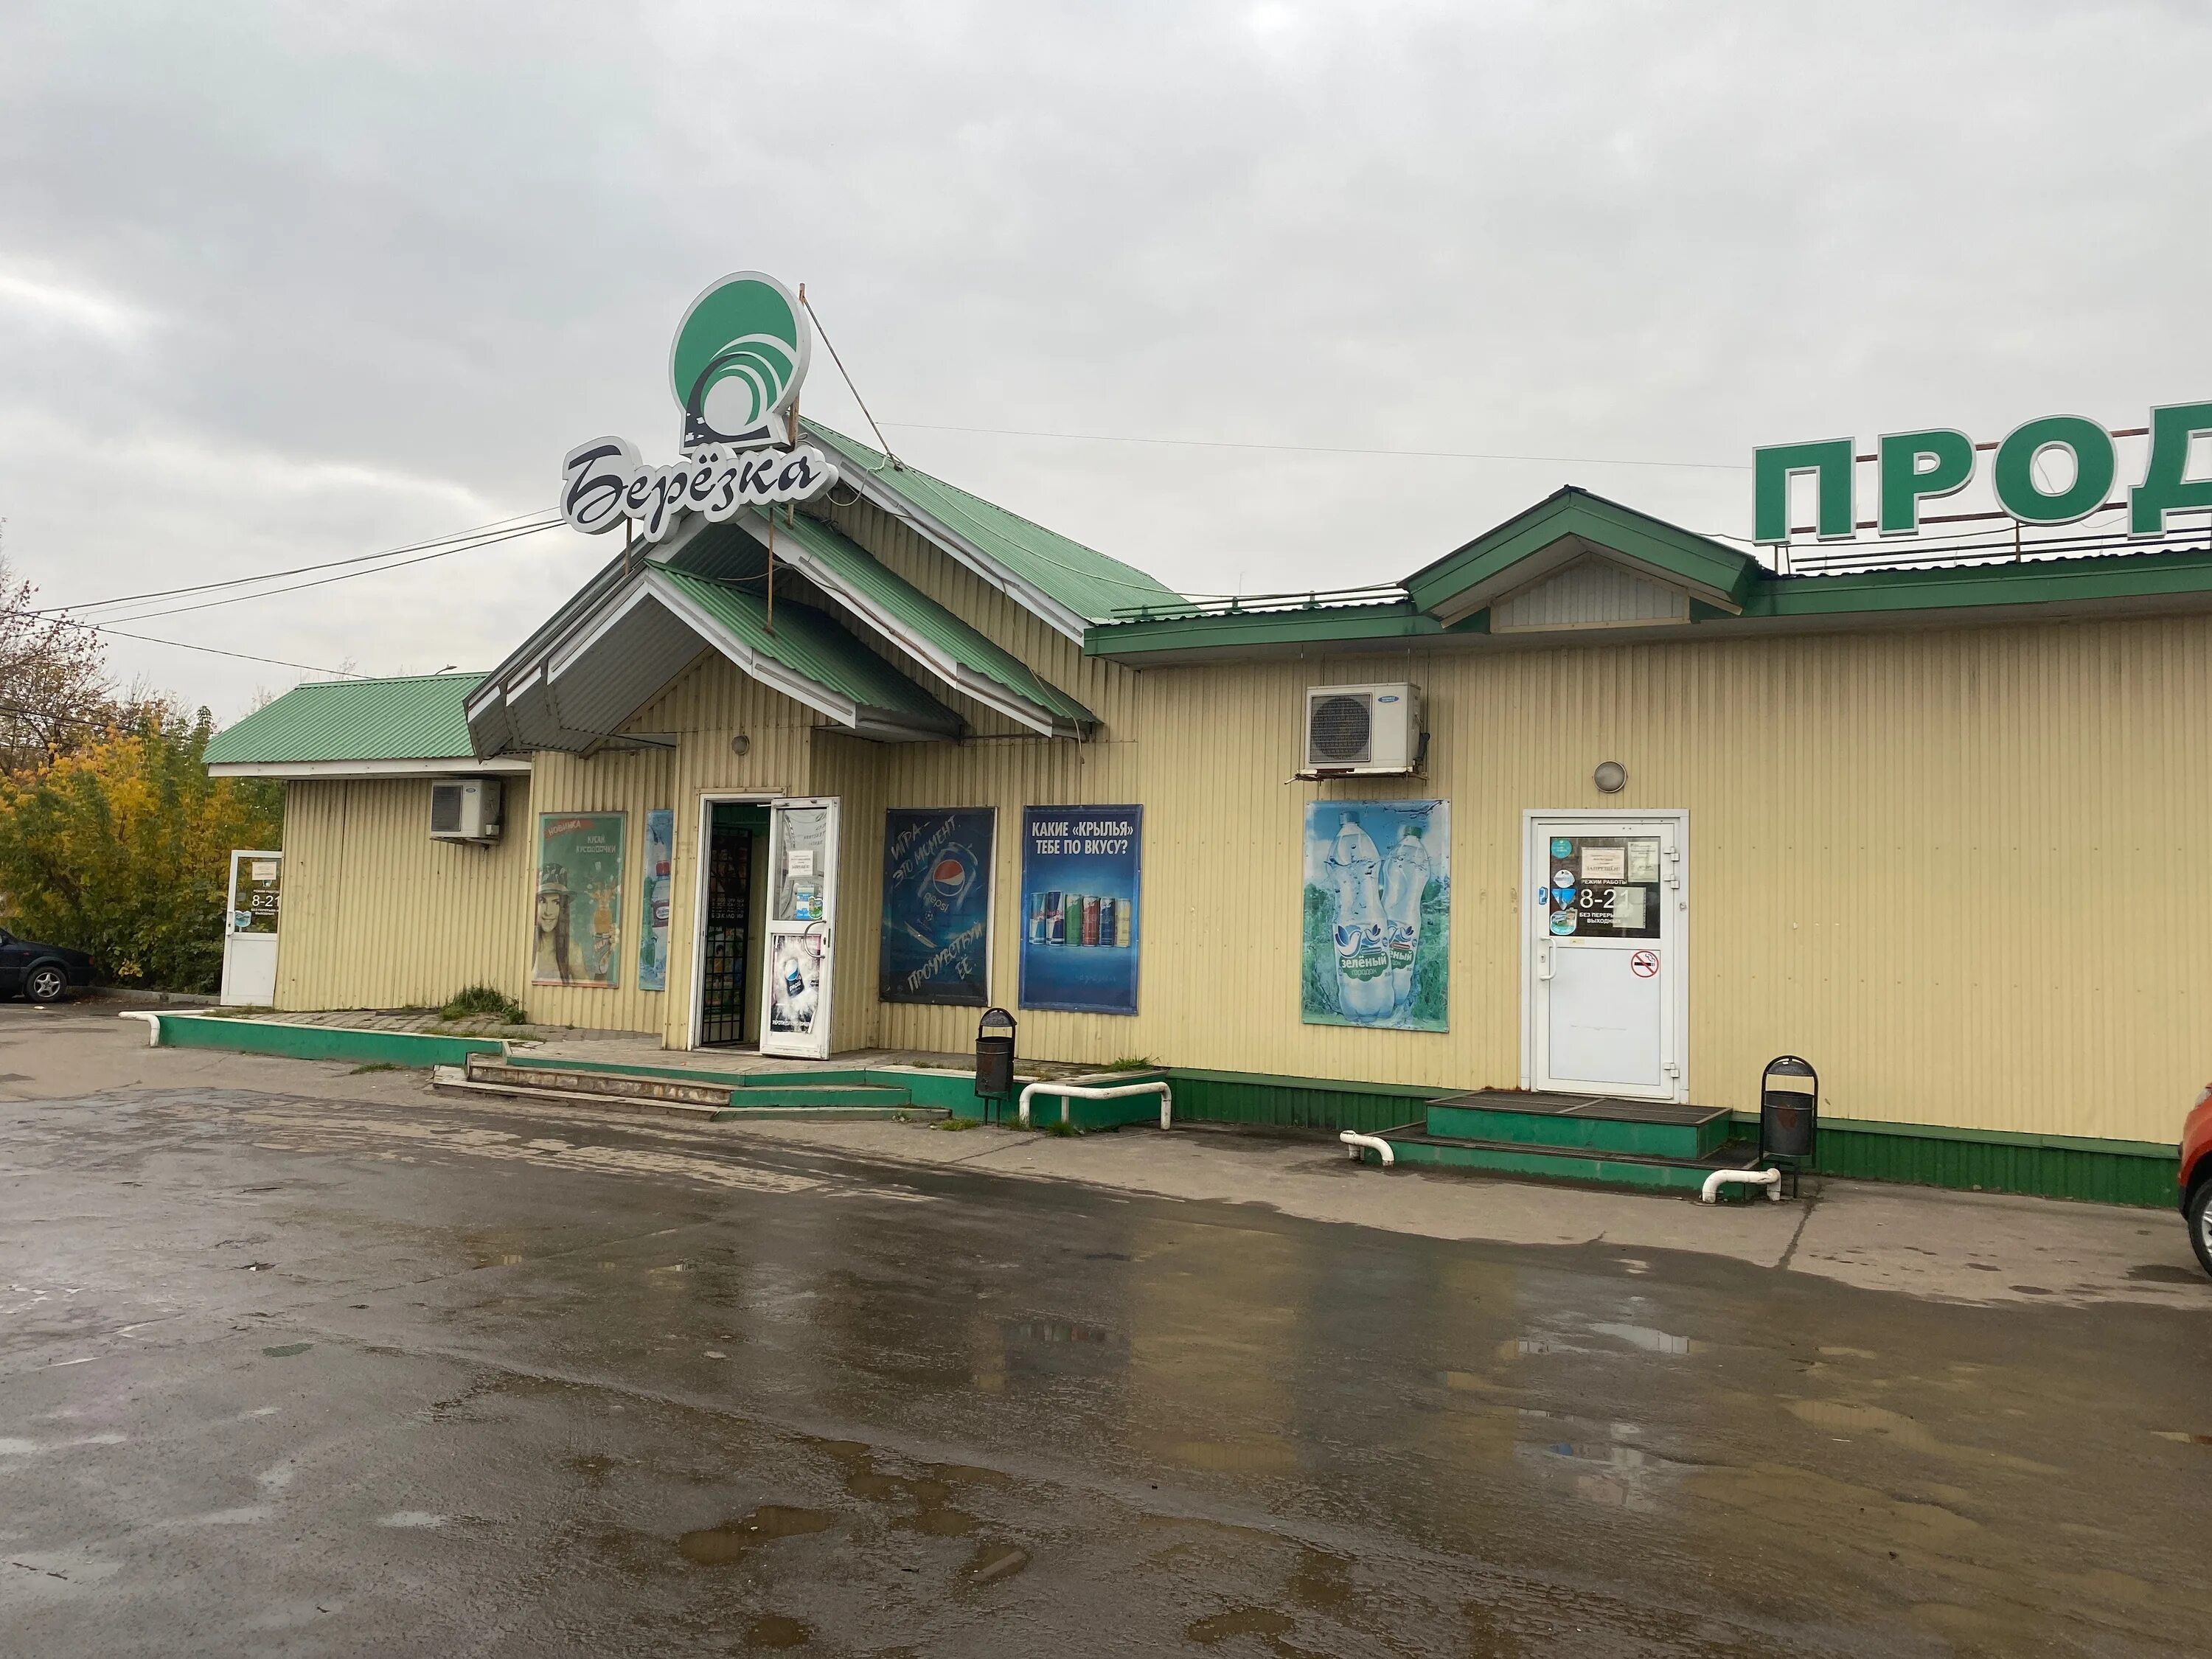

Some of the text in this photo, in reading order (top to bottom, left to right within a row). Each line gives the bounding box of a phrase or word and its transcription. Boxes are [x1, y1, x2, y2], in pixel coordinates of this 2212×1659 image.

[566, 444, 821, 534] Берёзка
[548, 819, 582, 836] НОВИНКА
[1032, 821, 1134, 837] КАКИЕ «КРЫЛЬЯ»
[1036, 839, 1128, 855] ТЕБЕ ПО ВКУСУ?
[892, 859, 914, 888] ЭТО
[922, 892, 950, 913] pepsi
[1342, 953, 1386, 968] зелёный
